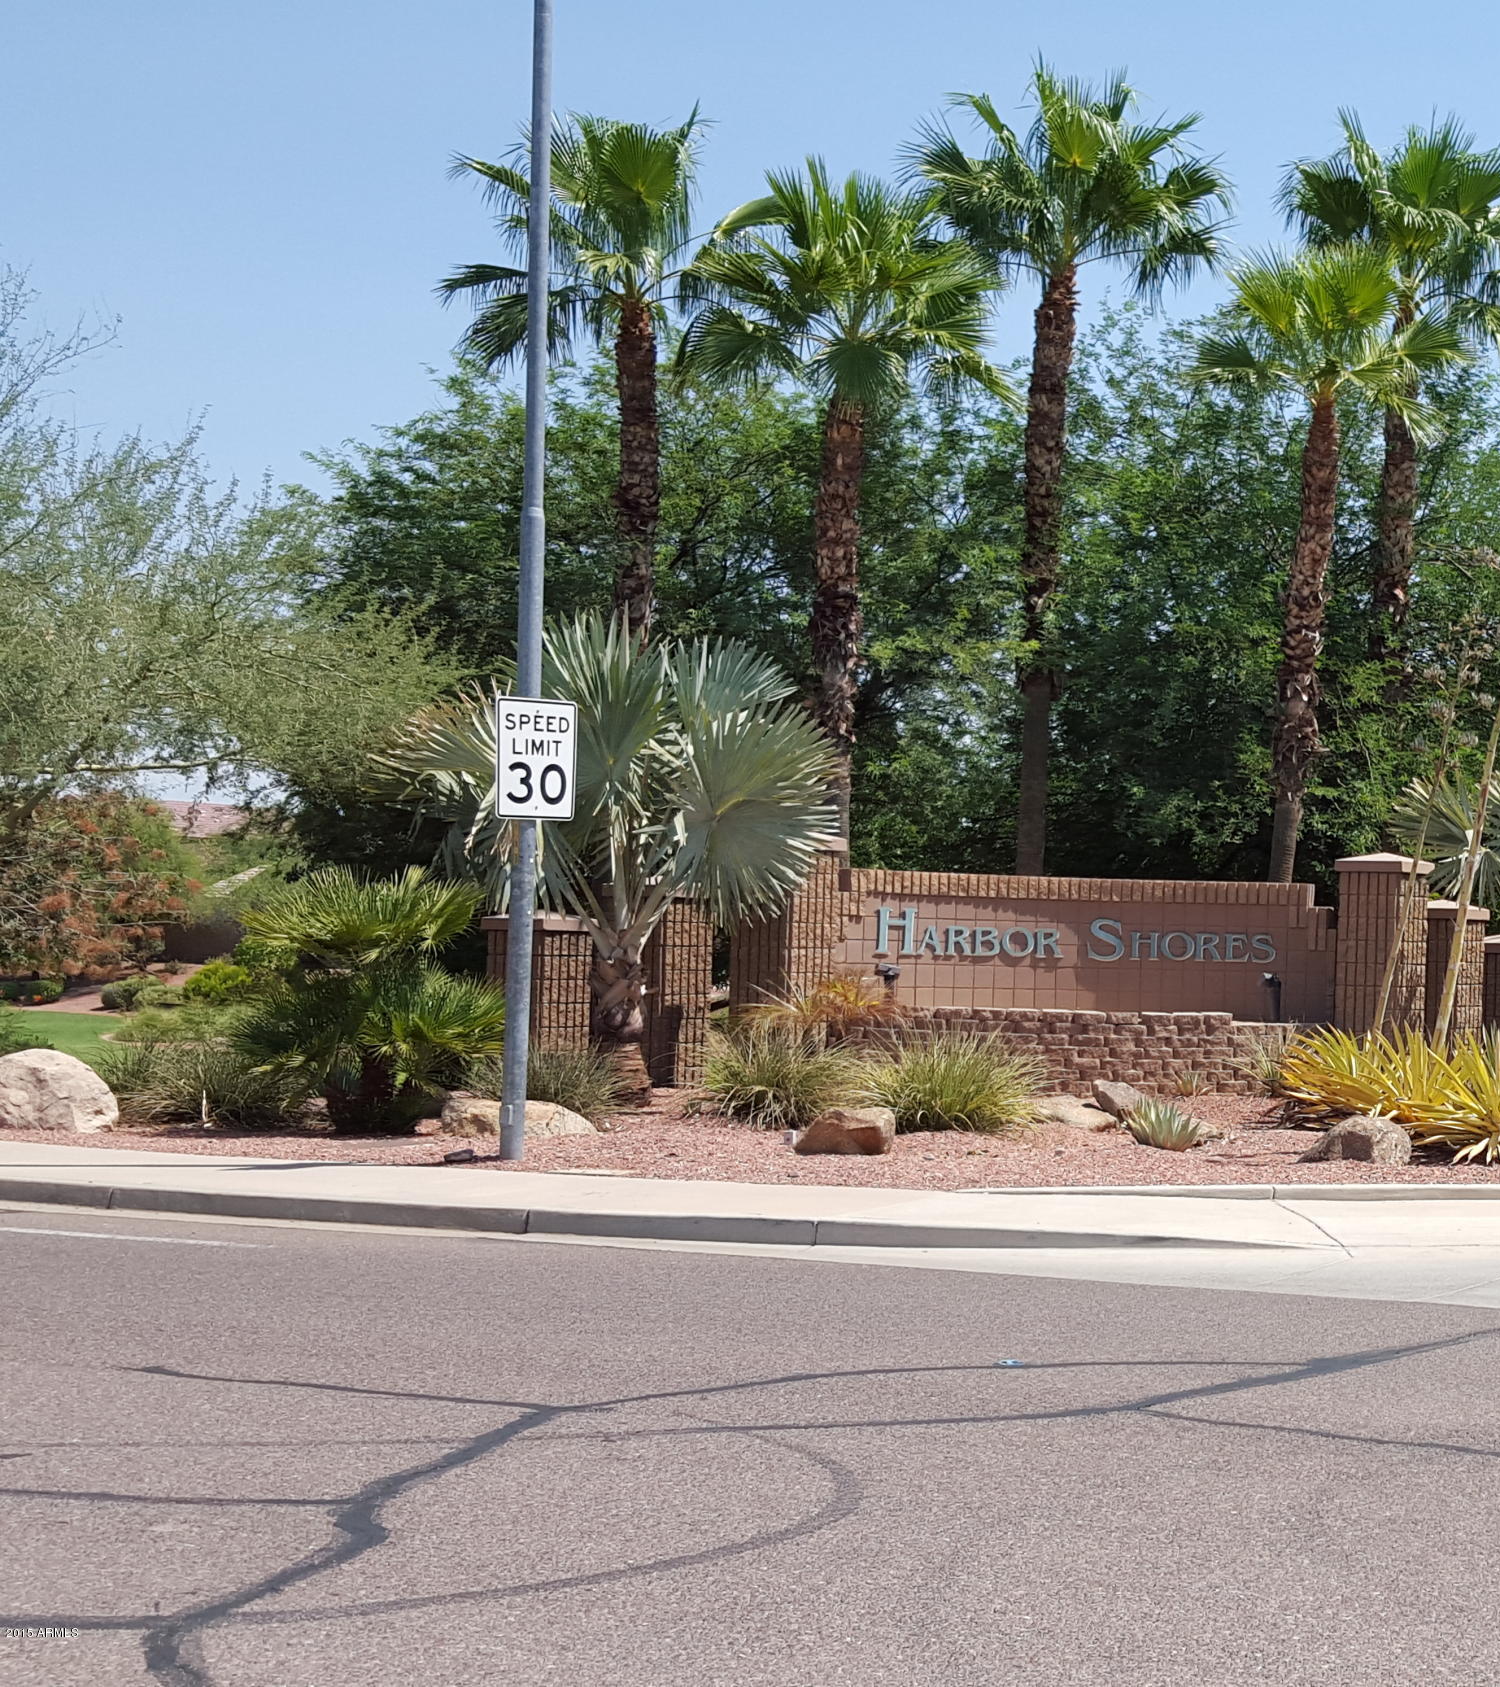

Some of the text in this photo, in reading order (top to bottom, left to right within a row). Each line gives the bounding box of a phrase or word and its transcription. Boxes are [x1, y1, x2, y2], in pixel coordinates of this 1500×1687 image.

[505, 713, 570, 733] SPEED
[512, 738, 562, 757] LIMIT
[506, 761, 567, 805] 30
[872, 906, 1277, 963] HARBOR SHORES
